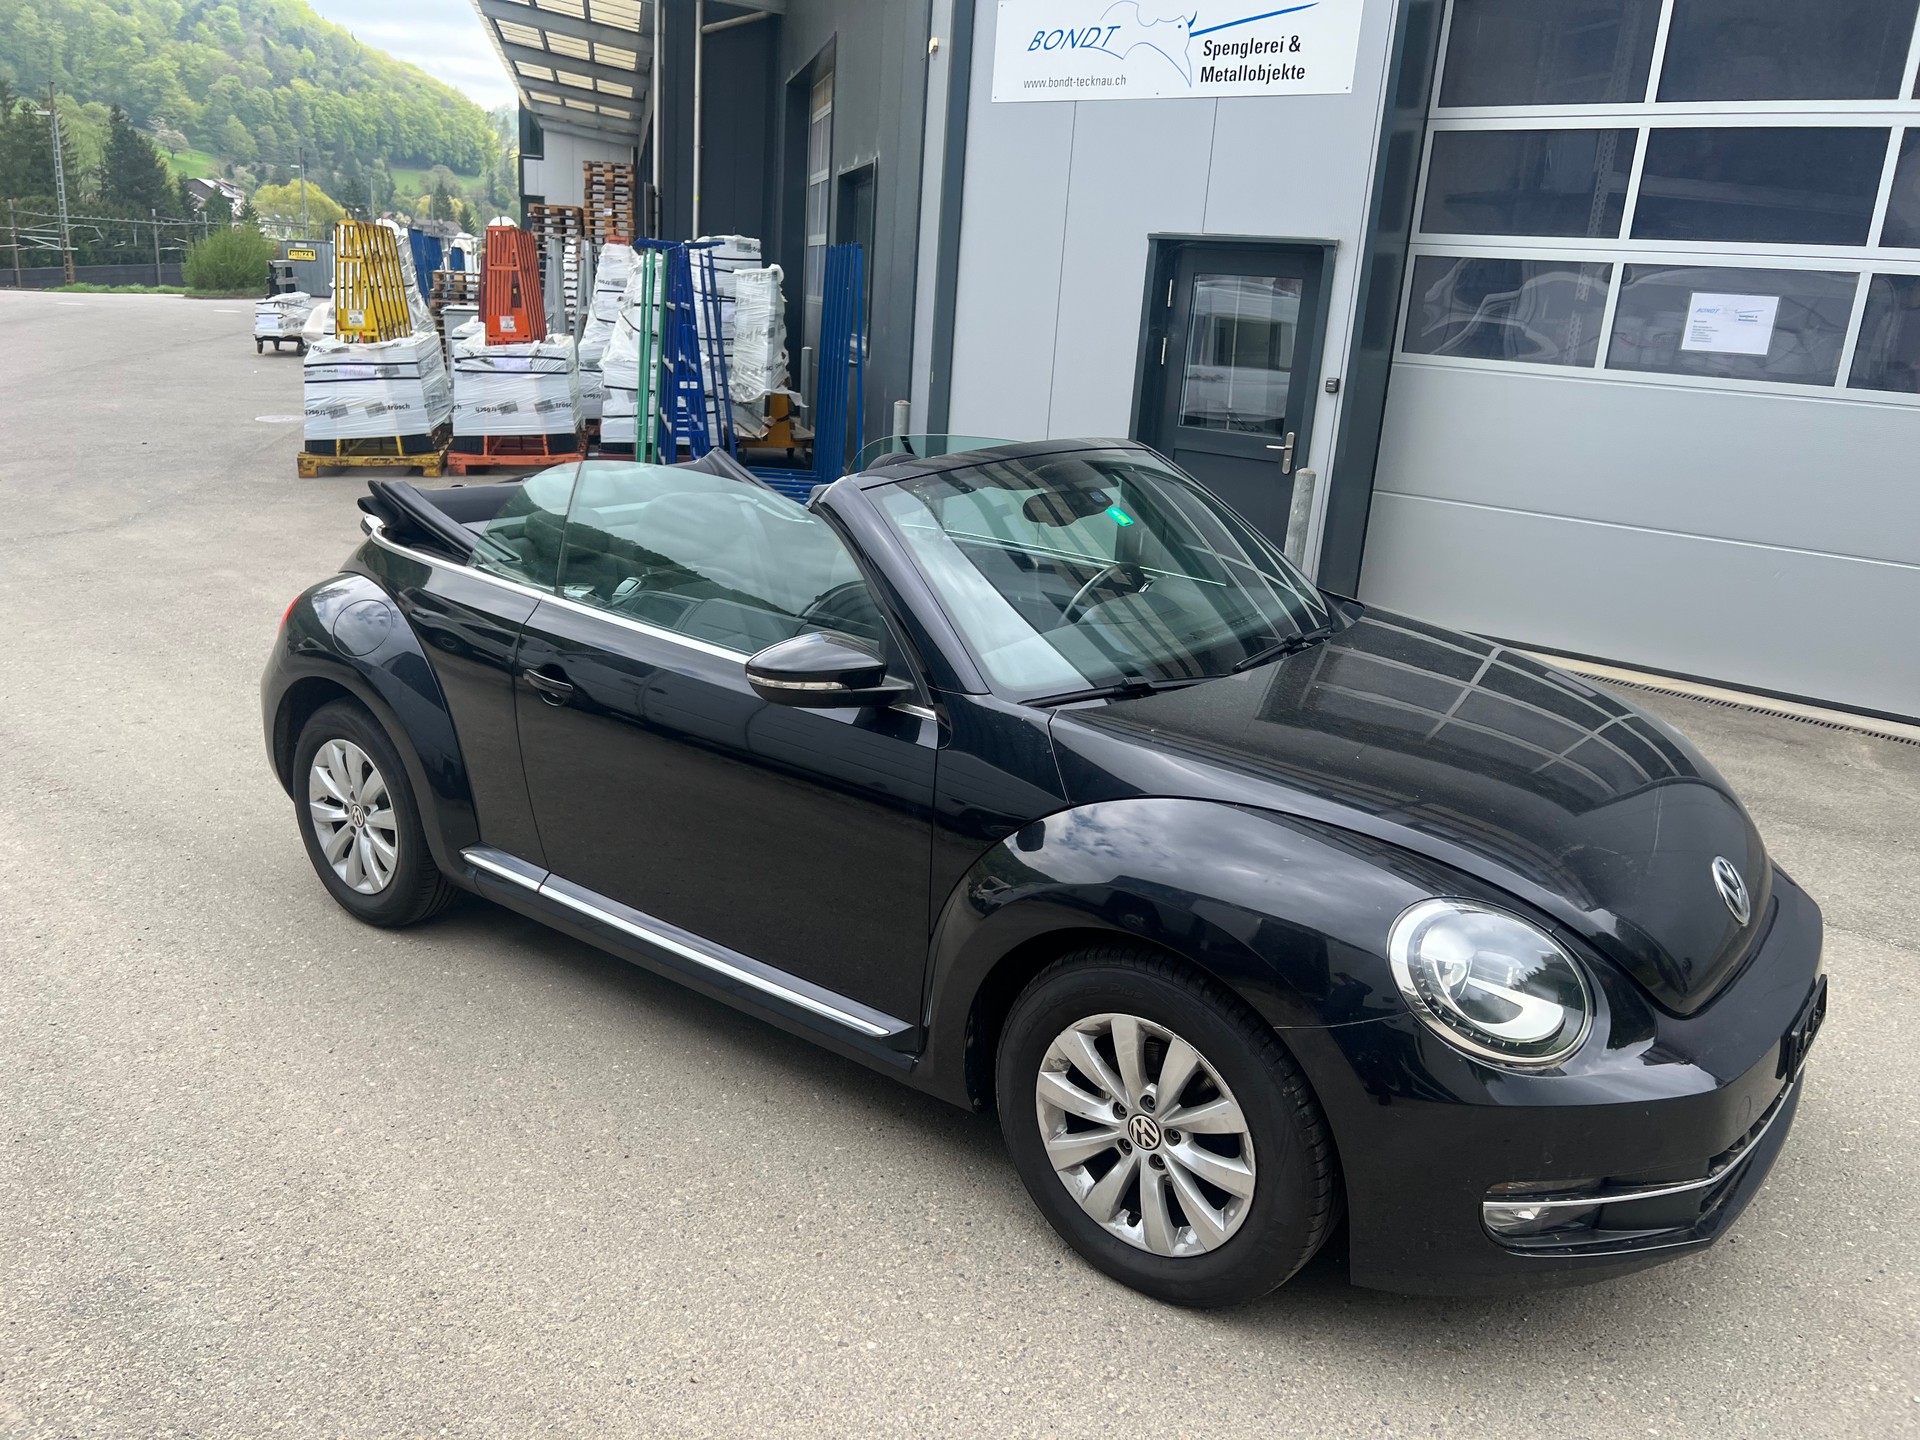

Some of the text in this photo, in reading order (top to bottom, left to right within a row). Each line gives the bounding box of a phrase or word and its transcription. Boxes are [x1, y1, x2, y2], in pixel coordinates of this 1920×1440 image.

[1027, 25, 1121, 51] BONDT
[1203, 34, 1301, 60] Spenglerei &
[1023, 74, 1127, 88] www.bondt-tecknau.ch
[1200, 63, 1306, 85] Metallobjekte
